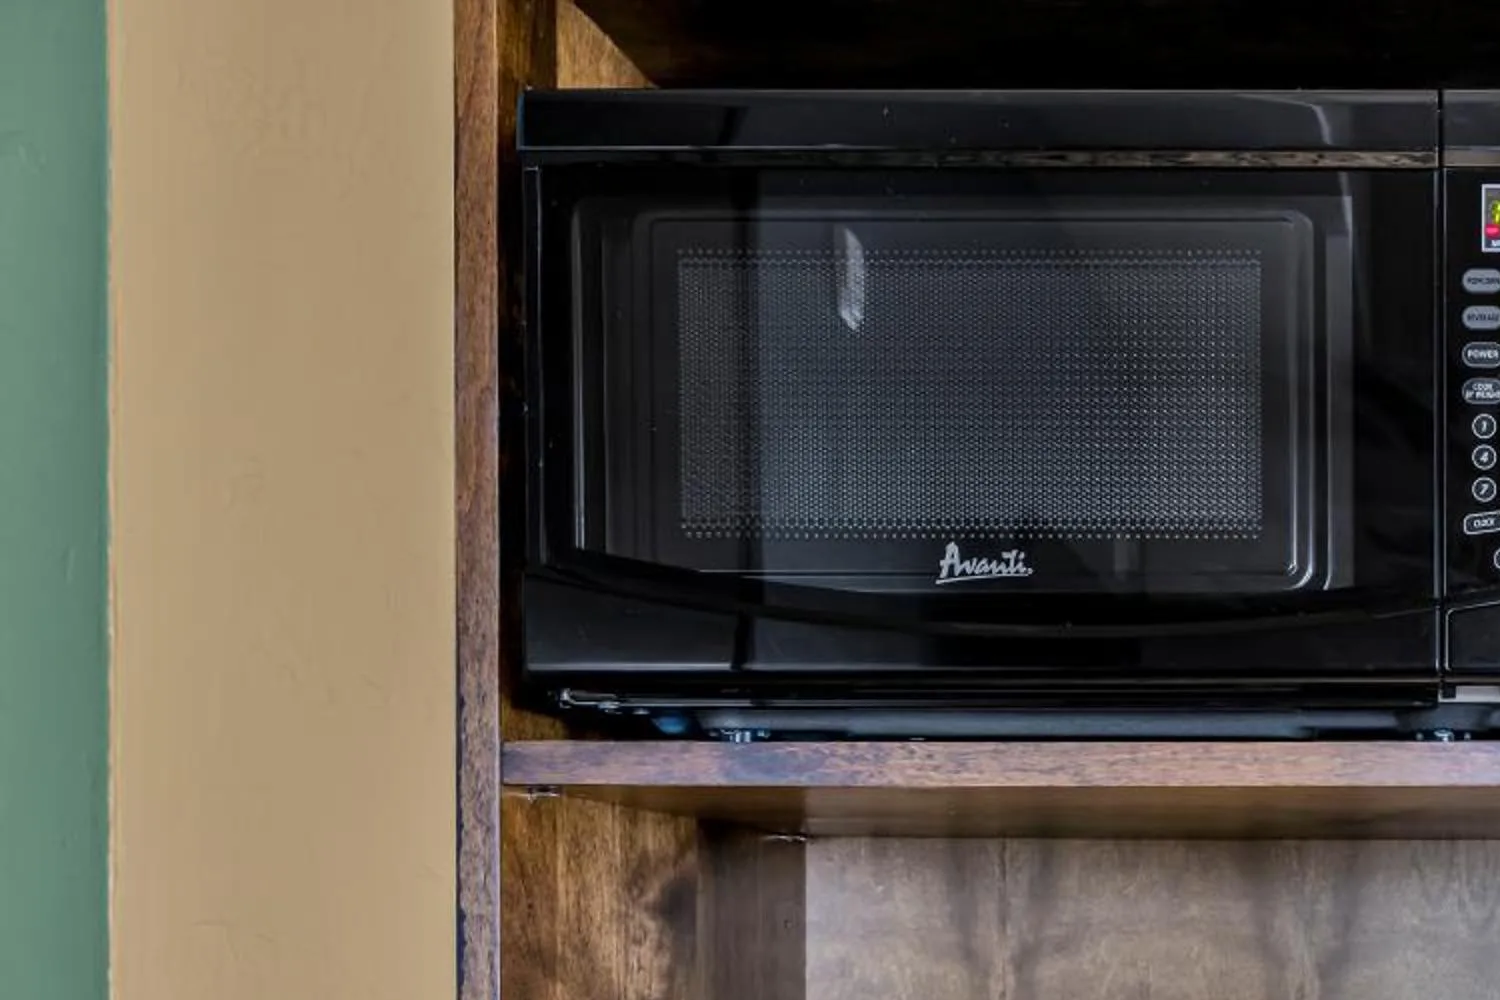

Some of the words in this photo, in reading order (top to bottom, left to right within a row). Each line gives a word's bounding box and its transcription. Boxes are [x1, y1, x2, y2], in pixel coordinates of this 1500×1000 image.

[1467, 349, 1499, 359] POWER
[1481, 421, 1488, 432] 1
[1480, 451, 1489, 463] 4
[1480, 483, 1489, 495] 7
